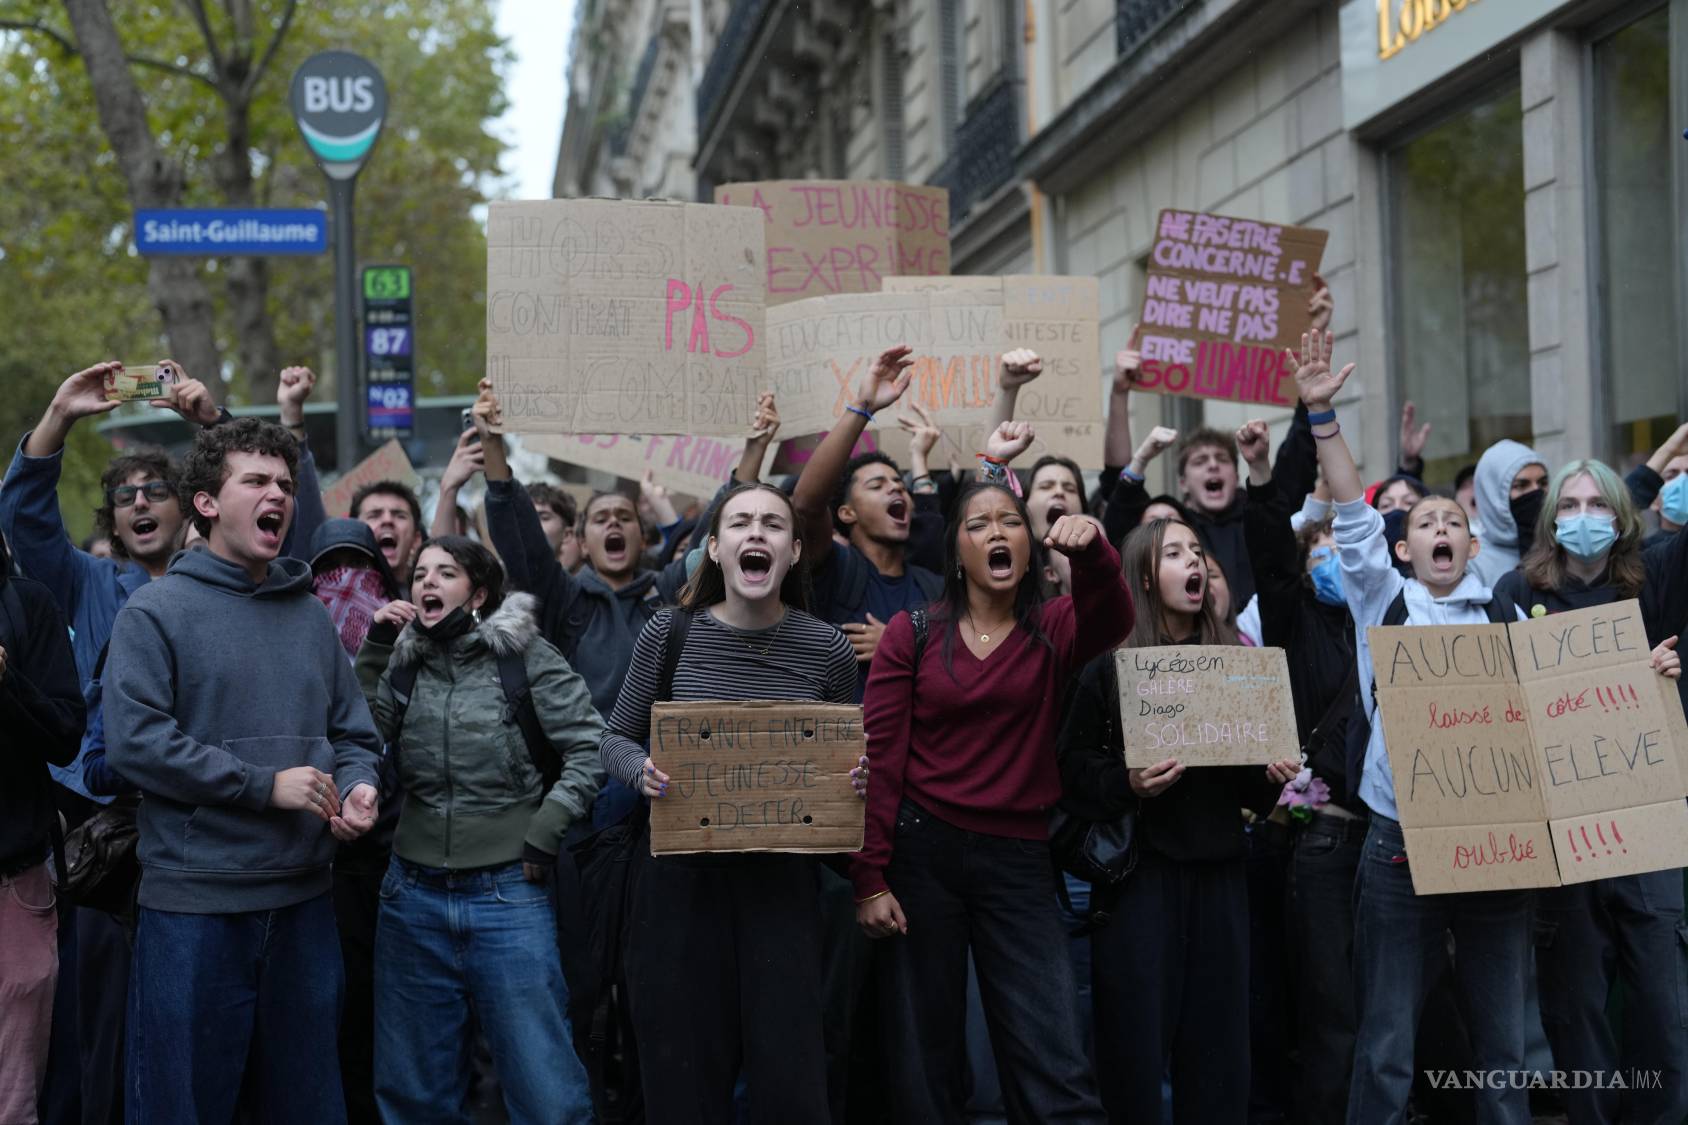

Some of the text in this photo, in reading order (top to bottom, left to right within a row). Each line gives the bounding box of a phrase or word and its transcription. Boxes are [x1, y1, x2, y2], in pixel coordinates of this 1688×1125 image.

[304, 76, 375, 112] BUS
[789, 185, 949, 239] JEUNESSE
[1160, 211, 1191, 240] NE
[143, 219, 319, 243] Saint-Guillaume
[509, 216, 675, 281] HORS
[371, 269, 401, 292] 63
[1147, 275, 1280, 315] NE VEUT PAS
[489, 278, 755, 359] CONTRAT PAS
[947, 308, 989, 343] UN
[1143, 299, 1279, 343] DIRE NE PAS
[371, 328, 407, 355] 87
[1141, 334, 1196, 364] ETRE
[583, 355, 763, 425] COMBAT
[1389, 616, 1638, 685] AUCUN LYCÉE
[1136, 677, 1197, 697] GALÈRE
[1139, 699, 1185, 719] Diago
[1428, 702, 1493, 729] laissé
[1505, 700, 1526, 724] de
[1546, 688, 1593, 719] côté
[657, 715, 759, 752] FRANCE
[1145, 719, 1270, 750] SOLIDAIRE
[677, 759, 819, 800] JEUNESSE
[1410, 745, 1533, 802] AUCUN
[714, 797, 807, 831] DETER
[1452, 831, 1539, 870] oublié
